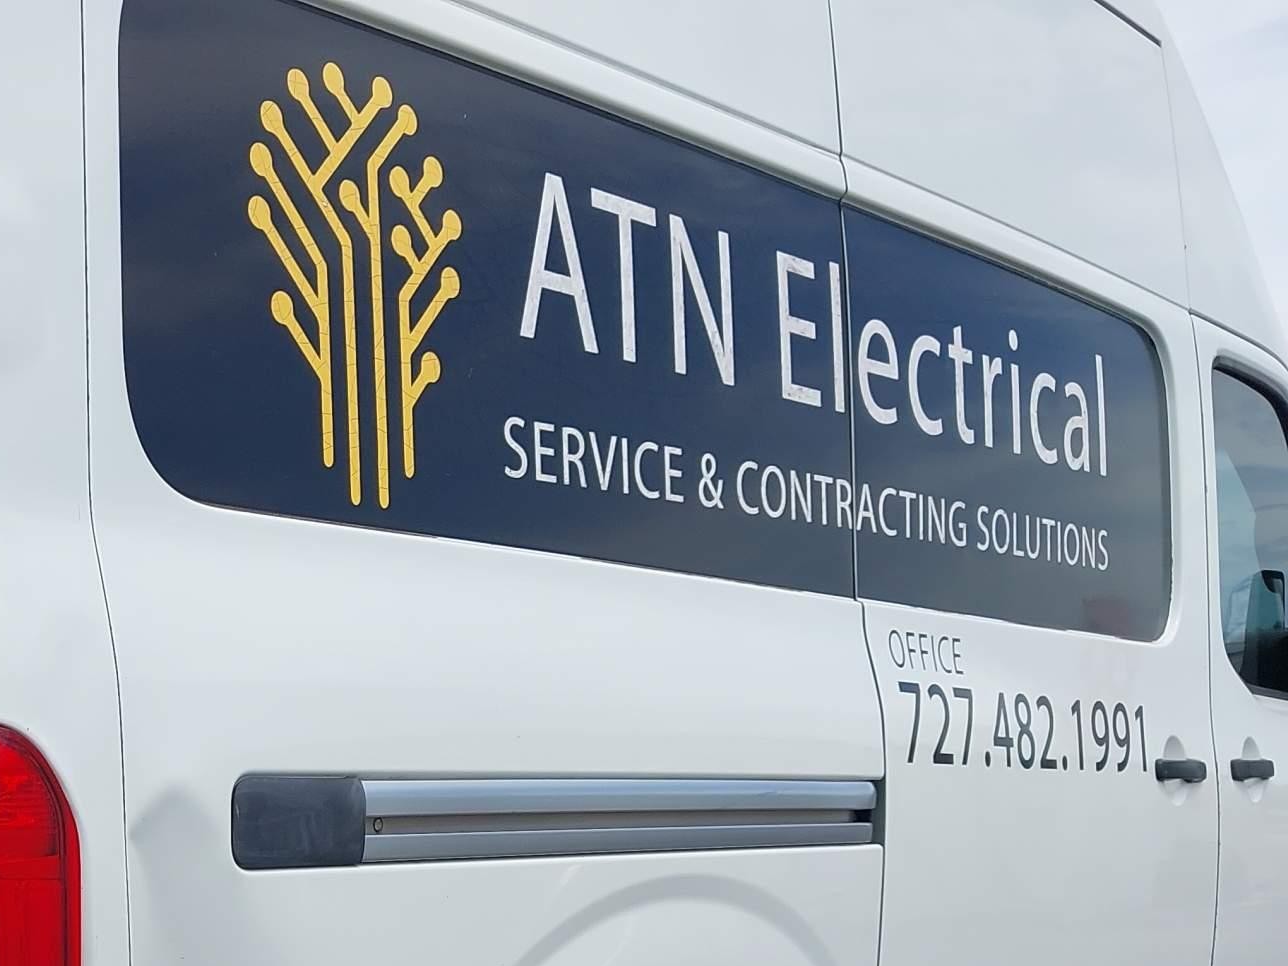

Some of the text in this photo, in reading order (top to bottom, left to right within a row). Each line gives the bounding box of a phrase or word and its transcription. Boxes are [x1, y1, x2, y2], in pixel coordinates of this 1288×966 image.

[519, 172, 1107, 477] ATN Electrical
[503, 416, 1109, 571] SERVICE & CONTRACTING SOLUTIONS
[888, 629, 964, 675] OFFICE
[897, 681, 1148, 774] 727.482.1991
